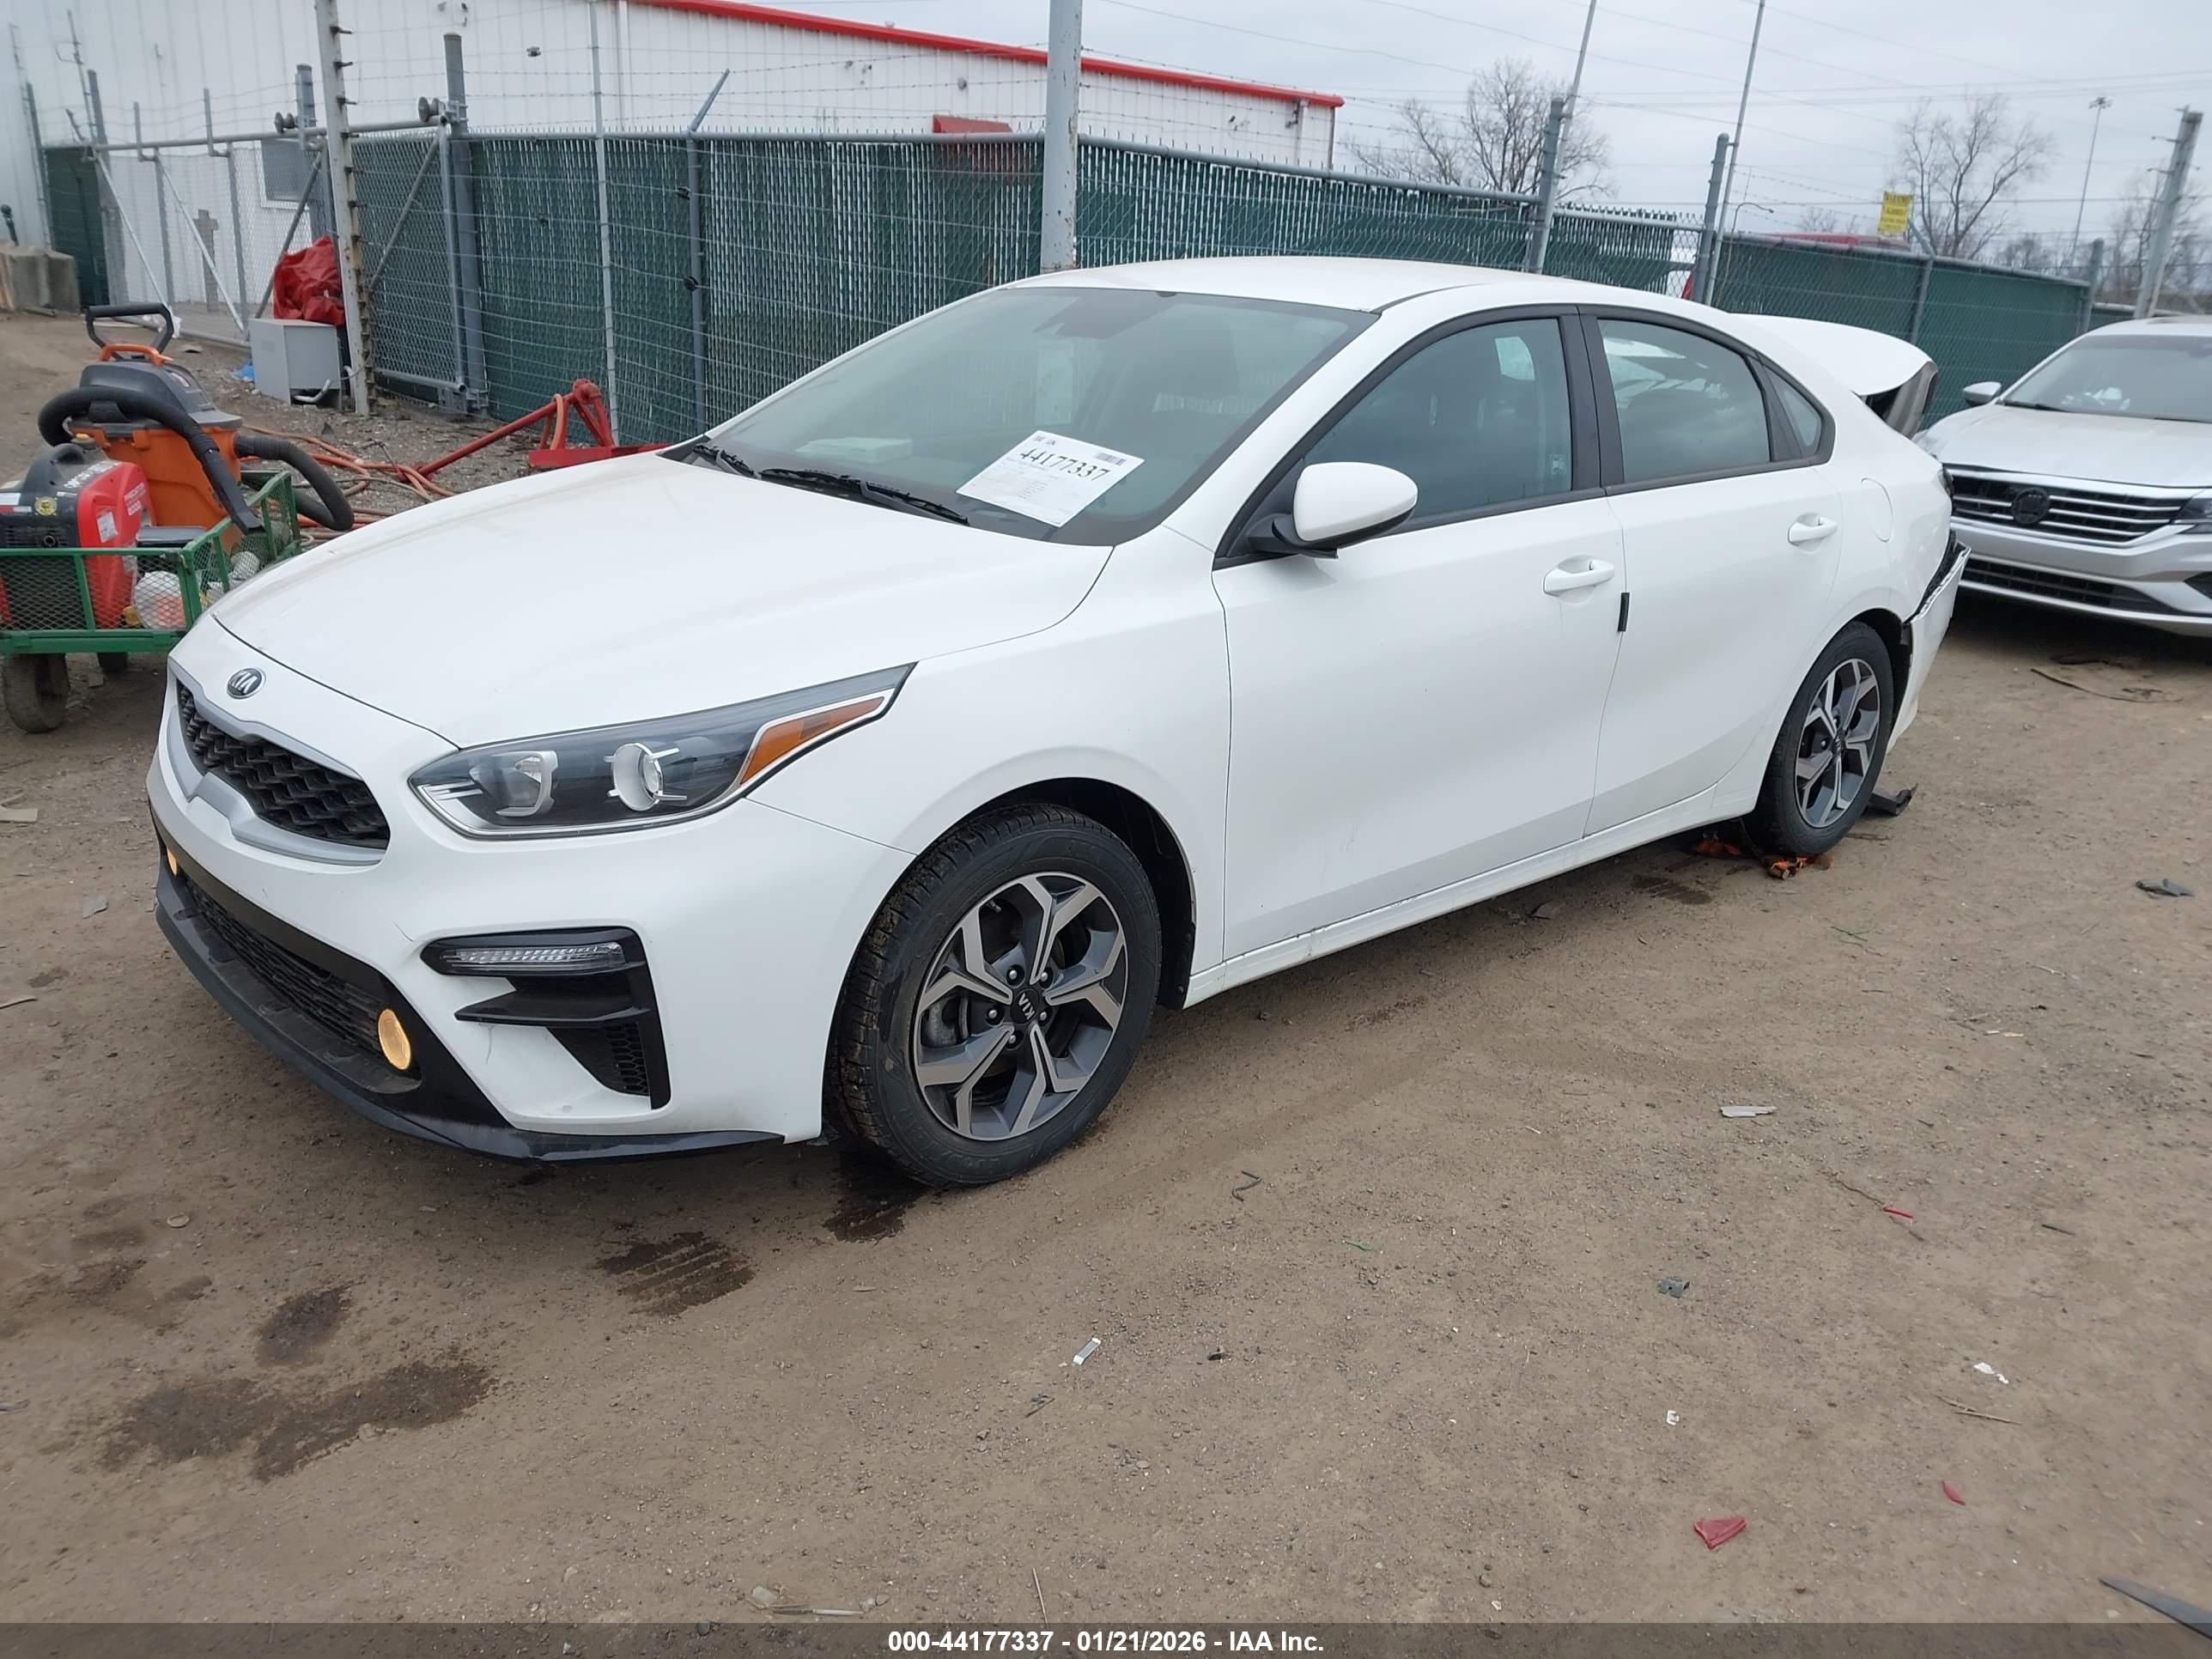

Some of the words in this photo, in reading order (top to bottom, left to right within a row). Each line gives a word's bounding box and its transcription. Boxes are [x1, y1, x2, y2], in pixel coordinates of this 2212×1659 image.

[1020, 448, 1110, 481] 44177337
[230, 670, 258, 694] KIA
[1018, 992, 1036, 1020] KIA
